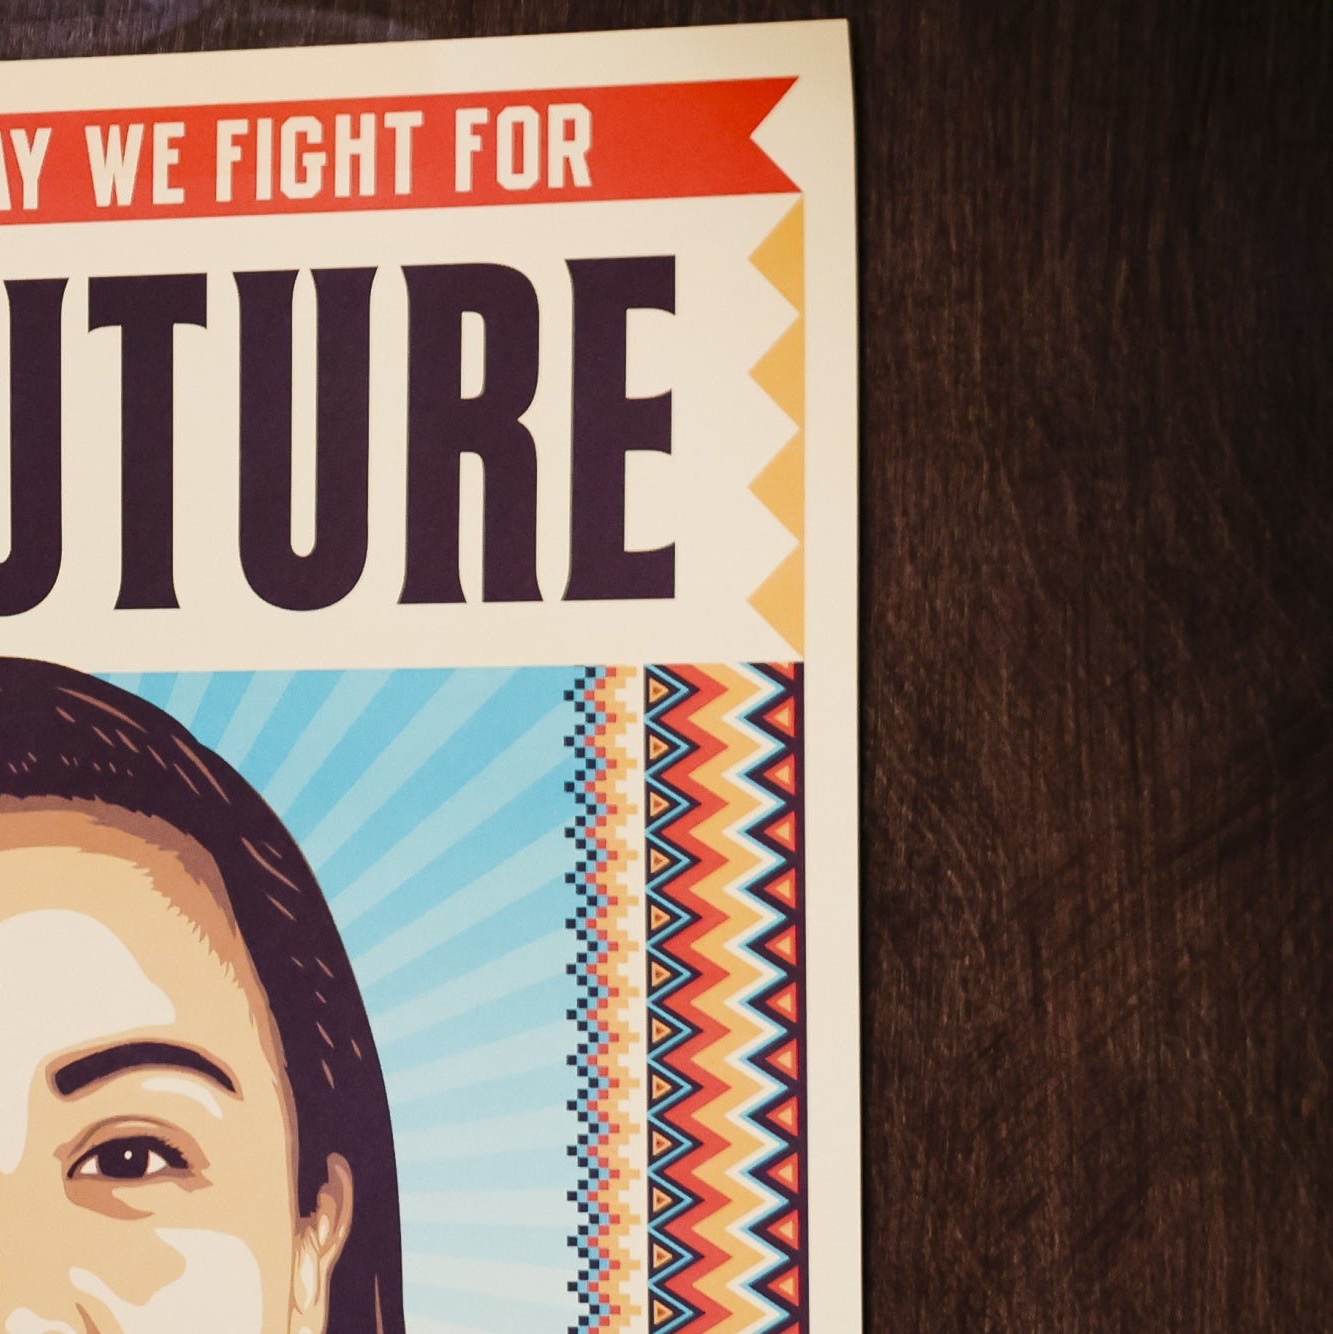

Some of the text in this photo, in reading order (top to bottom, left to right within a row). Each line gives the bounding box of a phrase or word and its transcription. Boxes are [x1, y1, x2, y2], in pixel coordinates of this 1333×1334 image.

[85, 121, 186, 207] WE
[215, 111, 423, 203] FIGHT
[454, 103, 593, 193] FOR
